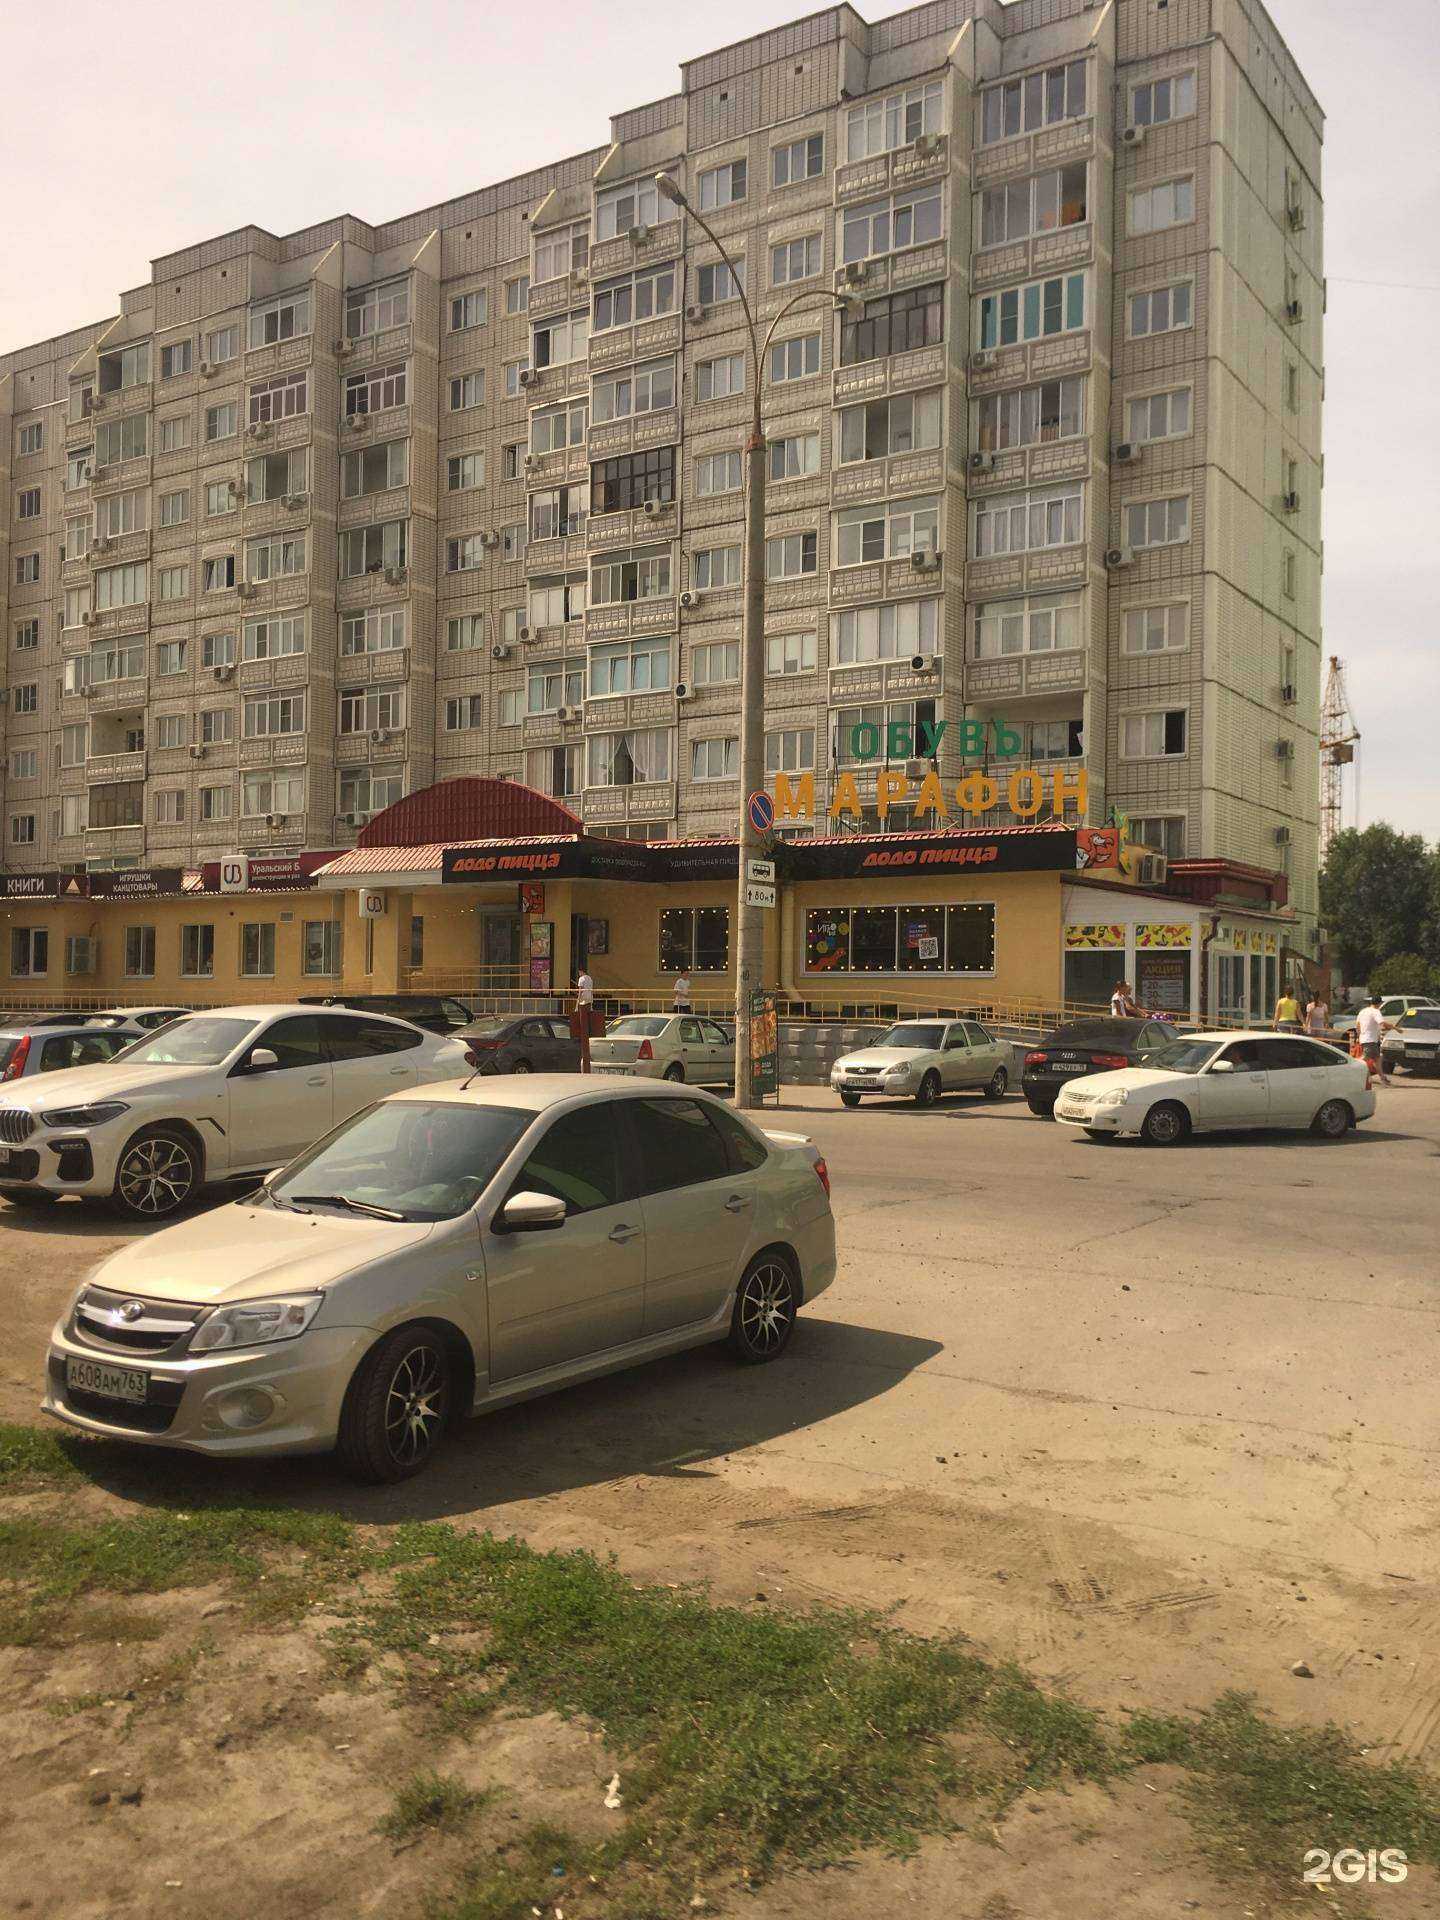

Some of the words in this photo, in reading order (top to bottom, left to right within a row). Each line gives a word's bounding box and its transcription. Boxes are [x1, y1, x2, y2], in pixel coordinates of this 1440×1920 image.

[850, 719, 1022, 759] ОБУВЬ
[775, 767, 1088, 819] МАРАФОН
[252, 862, 292, 875] Уральский
[119, 873, 151, 882] ИГРУШКИ
[7, 878, 44, 893] КНИГИ
[113, 882, 158, 892] КАНЦТОВАРЫ
